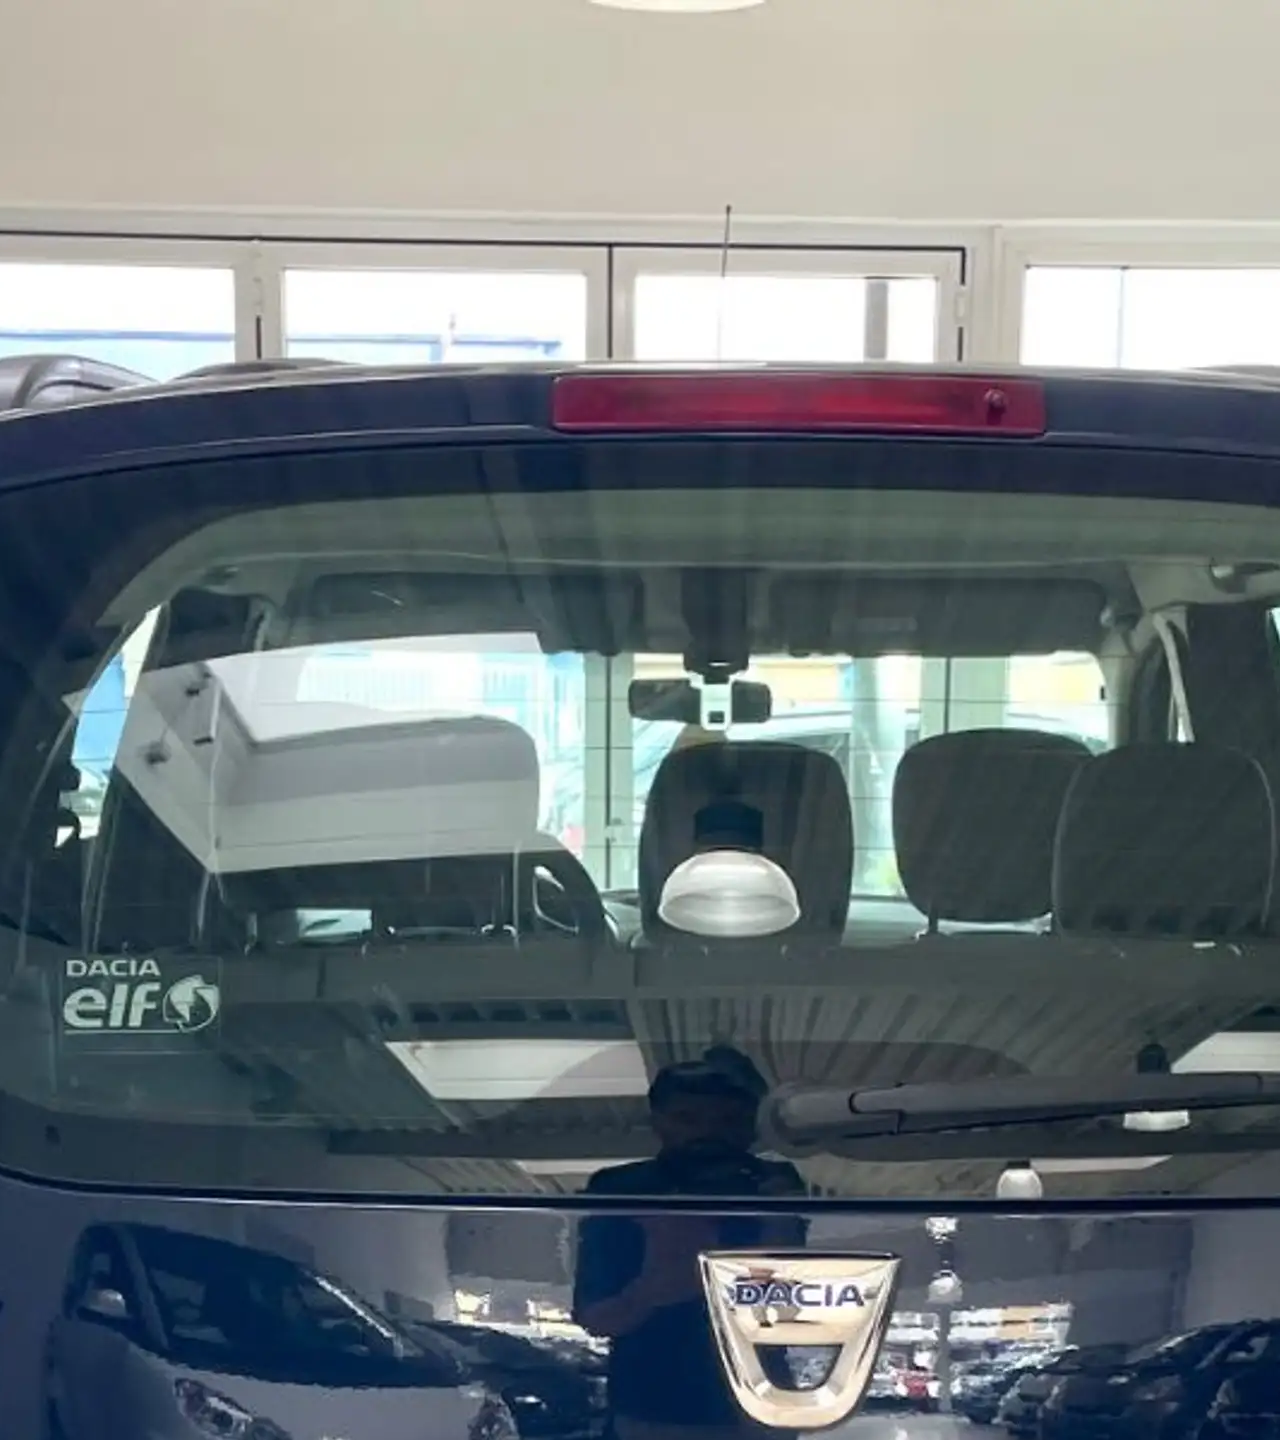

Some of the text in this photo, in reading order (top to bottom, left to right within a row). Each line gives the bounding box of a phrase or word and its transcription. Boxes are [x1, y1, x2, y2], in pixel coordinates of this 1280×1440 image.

[66, 959, 161, 977] DACIA
[63, 982, 161, 1028] elf
[734, 1281, 866, 1308] DACIA
